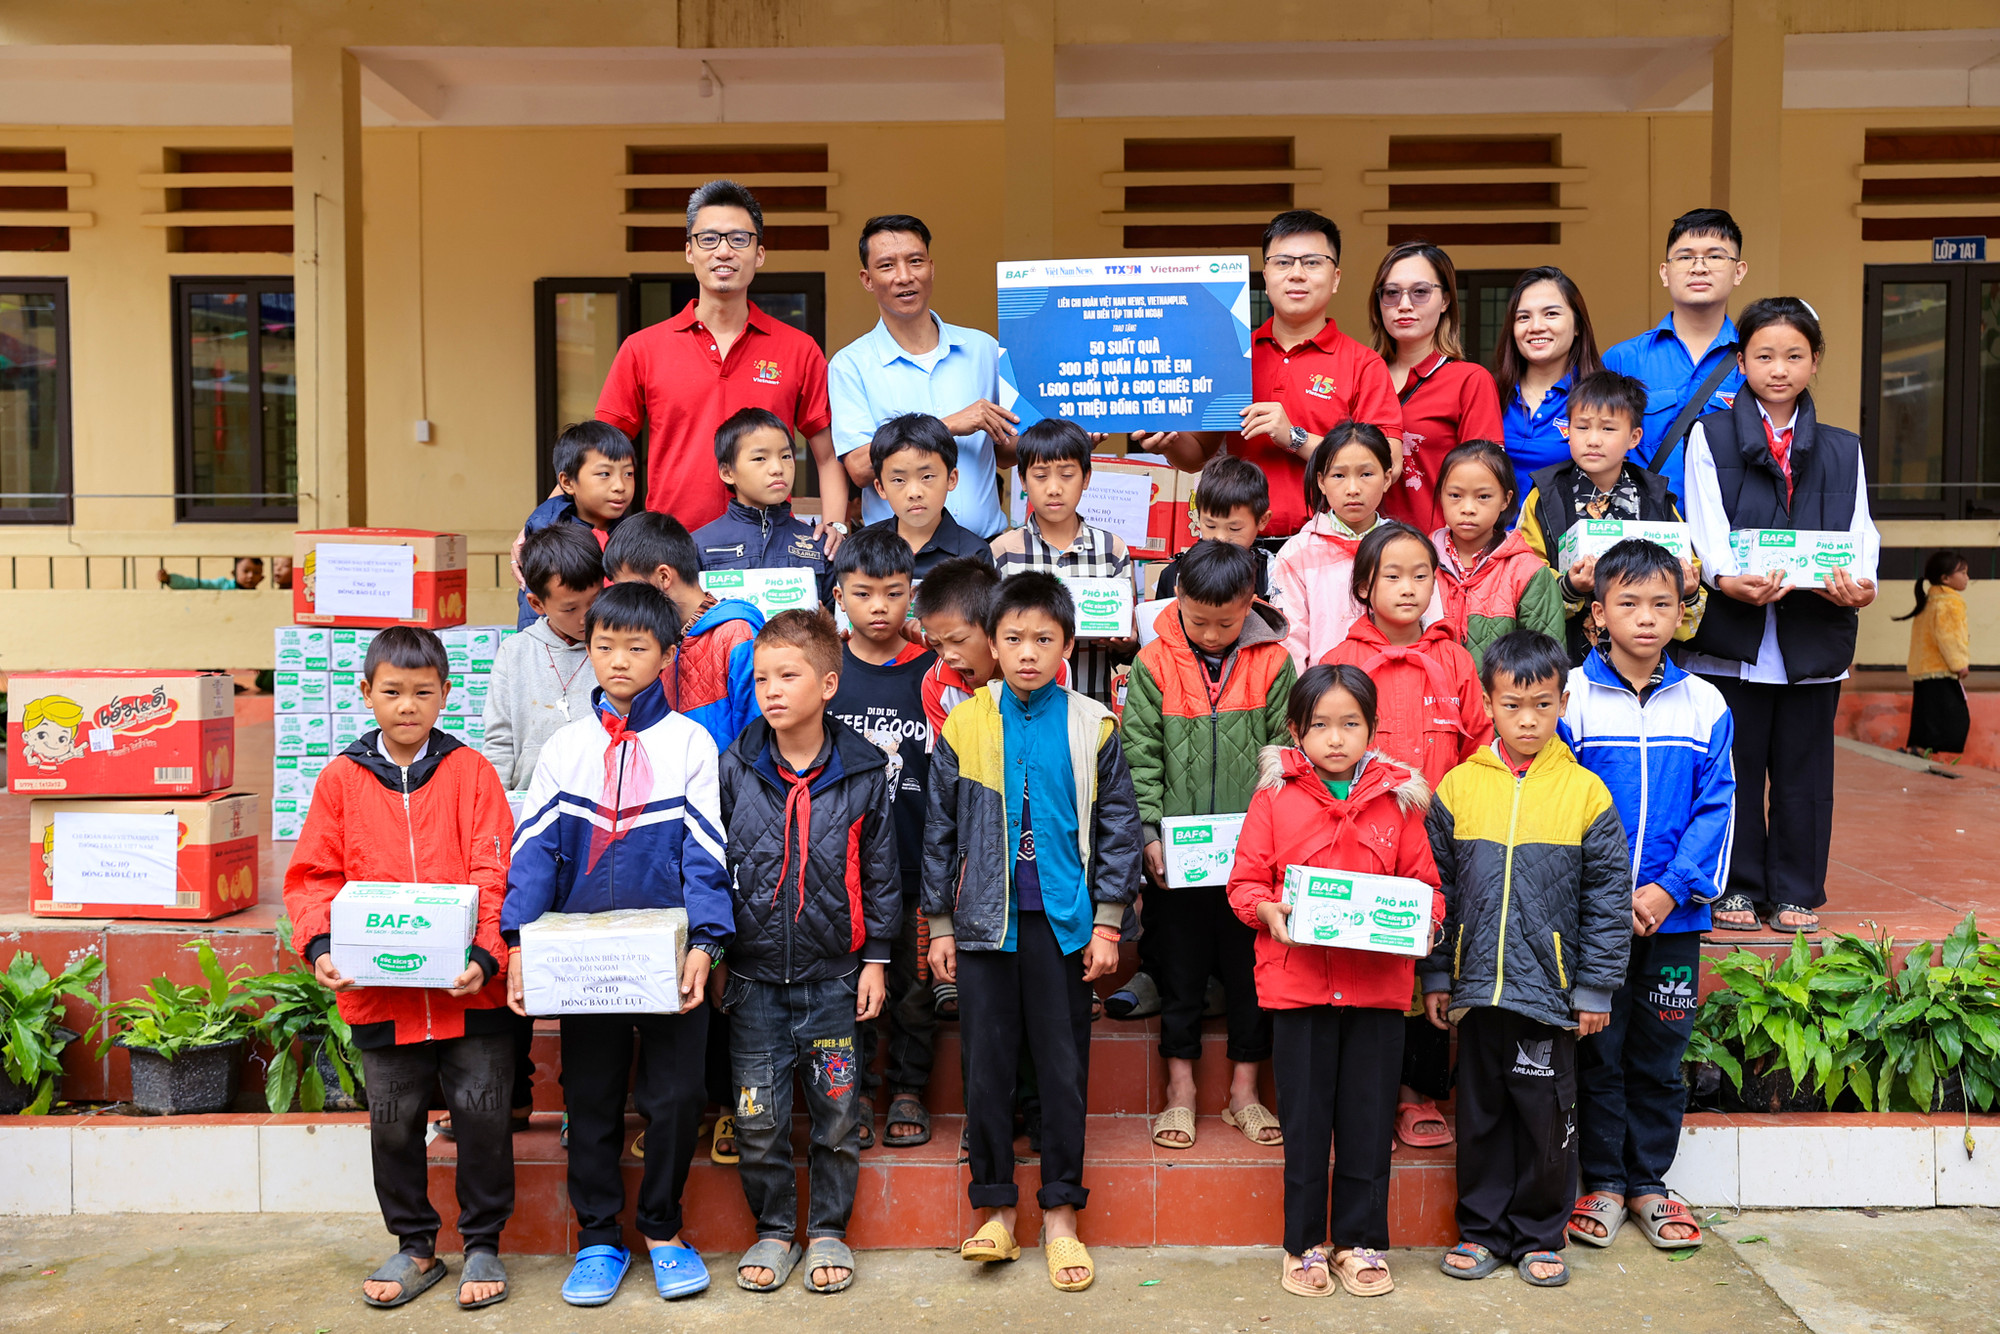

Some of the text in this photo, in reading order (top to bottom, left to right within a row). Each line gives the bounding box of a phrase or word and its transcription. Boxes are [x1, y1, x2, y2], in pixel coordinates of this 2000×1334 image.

[1935, 240, 1976, 259] LỚP 1A1
[1060, 267, 1075, 276] Nam
[1150, 264, 1200, 274] Vietnam+
[1005, 270, 1029, 279] BAF
[1057, 296, 1070, 308] LIÊN
[1071, 298, 1081, 308] CHI
[1082, 296, 1098, 308] ĐOÀN
[1099, 295, 1112, 308] VIỆT
[1113, 297, 1126, 307] NAM
[1083, 310, 1096, 319] BAN
[1097, 308, 1110, 319] BIÊN
[1111, 307, 1123, 320] TẬP
[1123, 309, 1133, 318] TIN
[1145, 308, 1163, 320] NGOẠI
[1089, 336, 1160, 355] 50 SUẤT QUÀ
[757, 360, 778, 380] 15
[1058, 362, 1082, 376] 300
[1084, 358, 1099, 378] BỘ
[1134, 357, 1149, 374] ÁO
[1151, 355, 1172, 374] TRẺ
[1174, 359, 1192, 373] EM
[1038, 376, 1213, 397] 1.600 CUỐN VỞ & 600 CHIẾC BÚT
[1312, 374, 1334, 394] 15
[1059, 402, 1074, 417] 30
[1077, 398, 1107, 418] TRIỆU
[1168, 396, 1194, 416] MẶT
[1589, 523, 1611, 531] BAF
[1643, 531, 1661, 539] PHÔ
[1761, 533, 1784, 542] BAF
[1816, 541, 1853, 550] PHÔ MAI
[708, 575, 731, 583] BAF
[765, 577, 803, 586] PHÔ MAI
[1082, 589, 1119, 598] PHÔ MAI
[886, 708, 898, 717] DU
[835, 714, 927, 741] EELGOOD
[1175, 830, 1199, 840] BAF
[1311, 881, 1338, 892] BAF
[1375, 896, 1418, 908] PHÔ MAI
[366, 913, 411, 928] BAF
[1401, 916, 1414, 926] 3T
[407, 958, 420, 968] 3T
[602, 954, 620, 962] BIÊN
[594, 964, 619, 972] NGOẠI
[554, 974, 579, 982] THÔNG
[1658, 966, 1692, 995] 32
[583, 985, 619, 995] ỨNG HỘ
[561, 996, 642, 1007] ĐỒNG BÀO LŨ LỤT
[1659, 1010, 1686, 1021] KID
[465, 1086, 503, 1112] Mill
[1581, 1200, 1611, 1212] NIKE
[1657, 1204, 1682, 1214] NIKE
